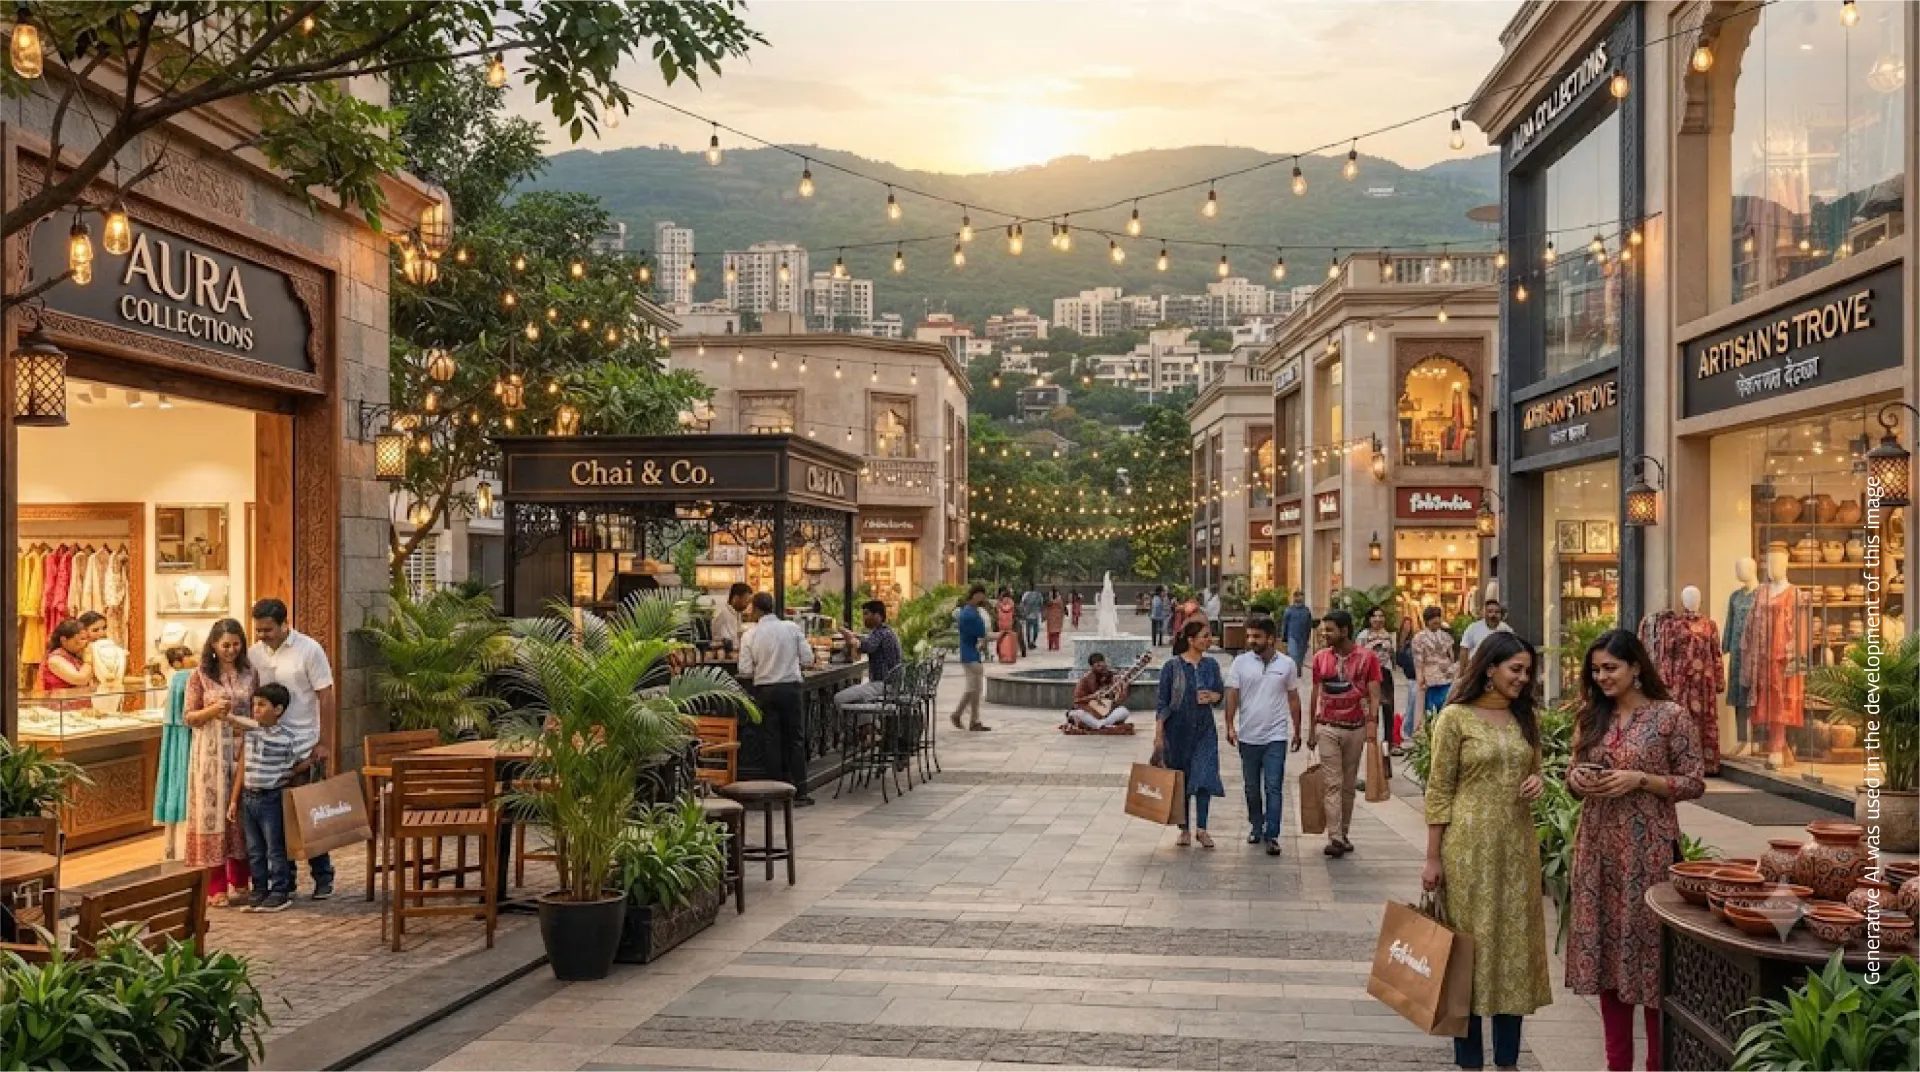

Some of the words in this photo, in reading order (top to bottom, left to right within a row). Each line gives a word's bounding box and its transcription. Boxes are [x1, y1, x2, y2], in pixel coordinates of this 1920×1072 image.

[124, 232, 252, 320] AURA
[121, 294, 253, 350] COLLECTIONS
[1697, 319, 1789, 379] ARTISAN'S
[1792, 288, 1870, 348] TROVE
[571, 459, 633, 486] Chai
[641, 460, 663, 485] &
[671, 460, 715, 485] Co.
